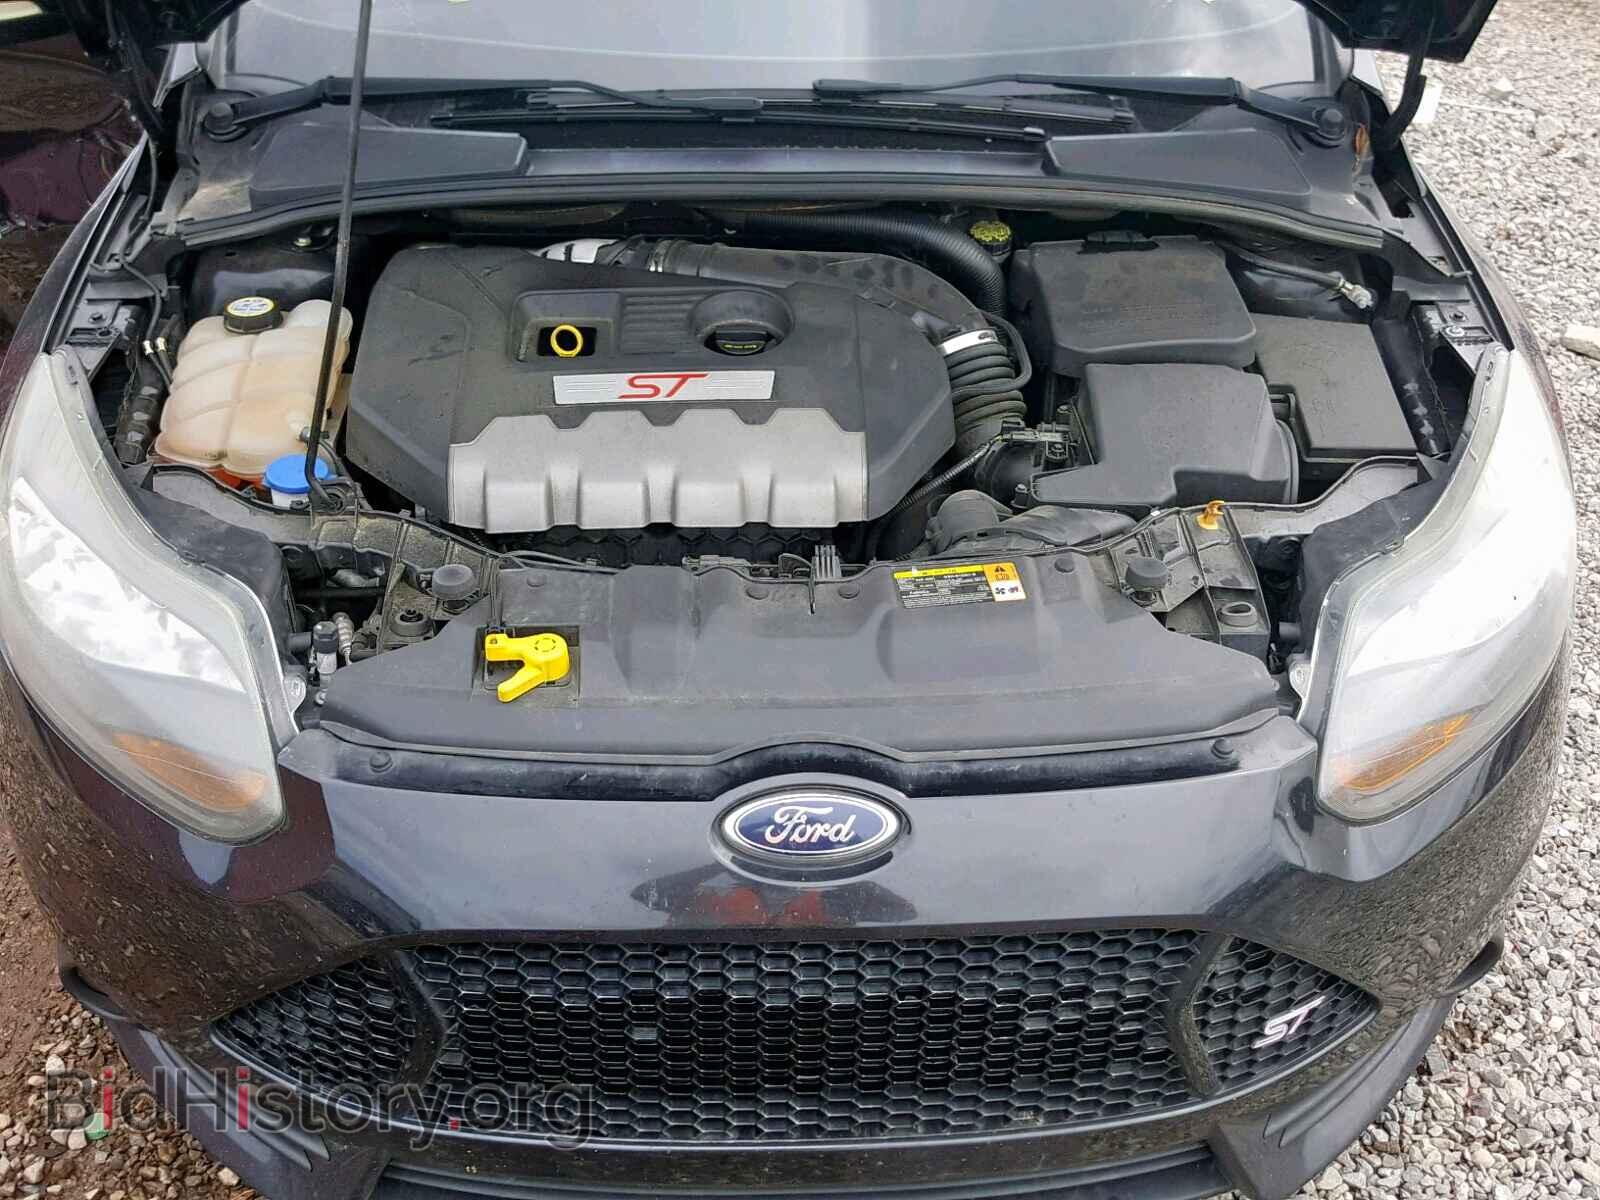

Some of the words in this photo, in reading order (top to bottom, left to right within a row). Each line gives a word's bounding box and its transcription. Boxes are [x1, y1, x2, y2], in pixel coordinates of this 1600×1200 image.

[618, 373, 709, 398] ST
[764, 805, 857, 844] Ford
[1250, 995, 1326, 1049] ST
